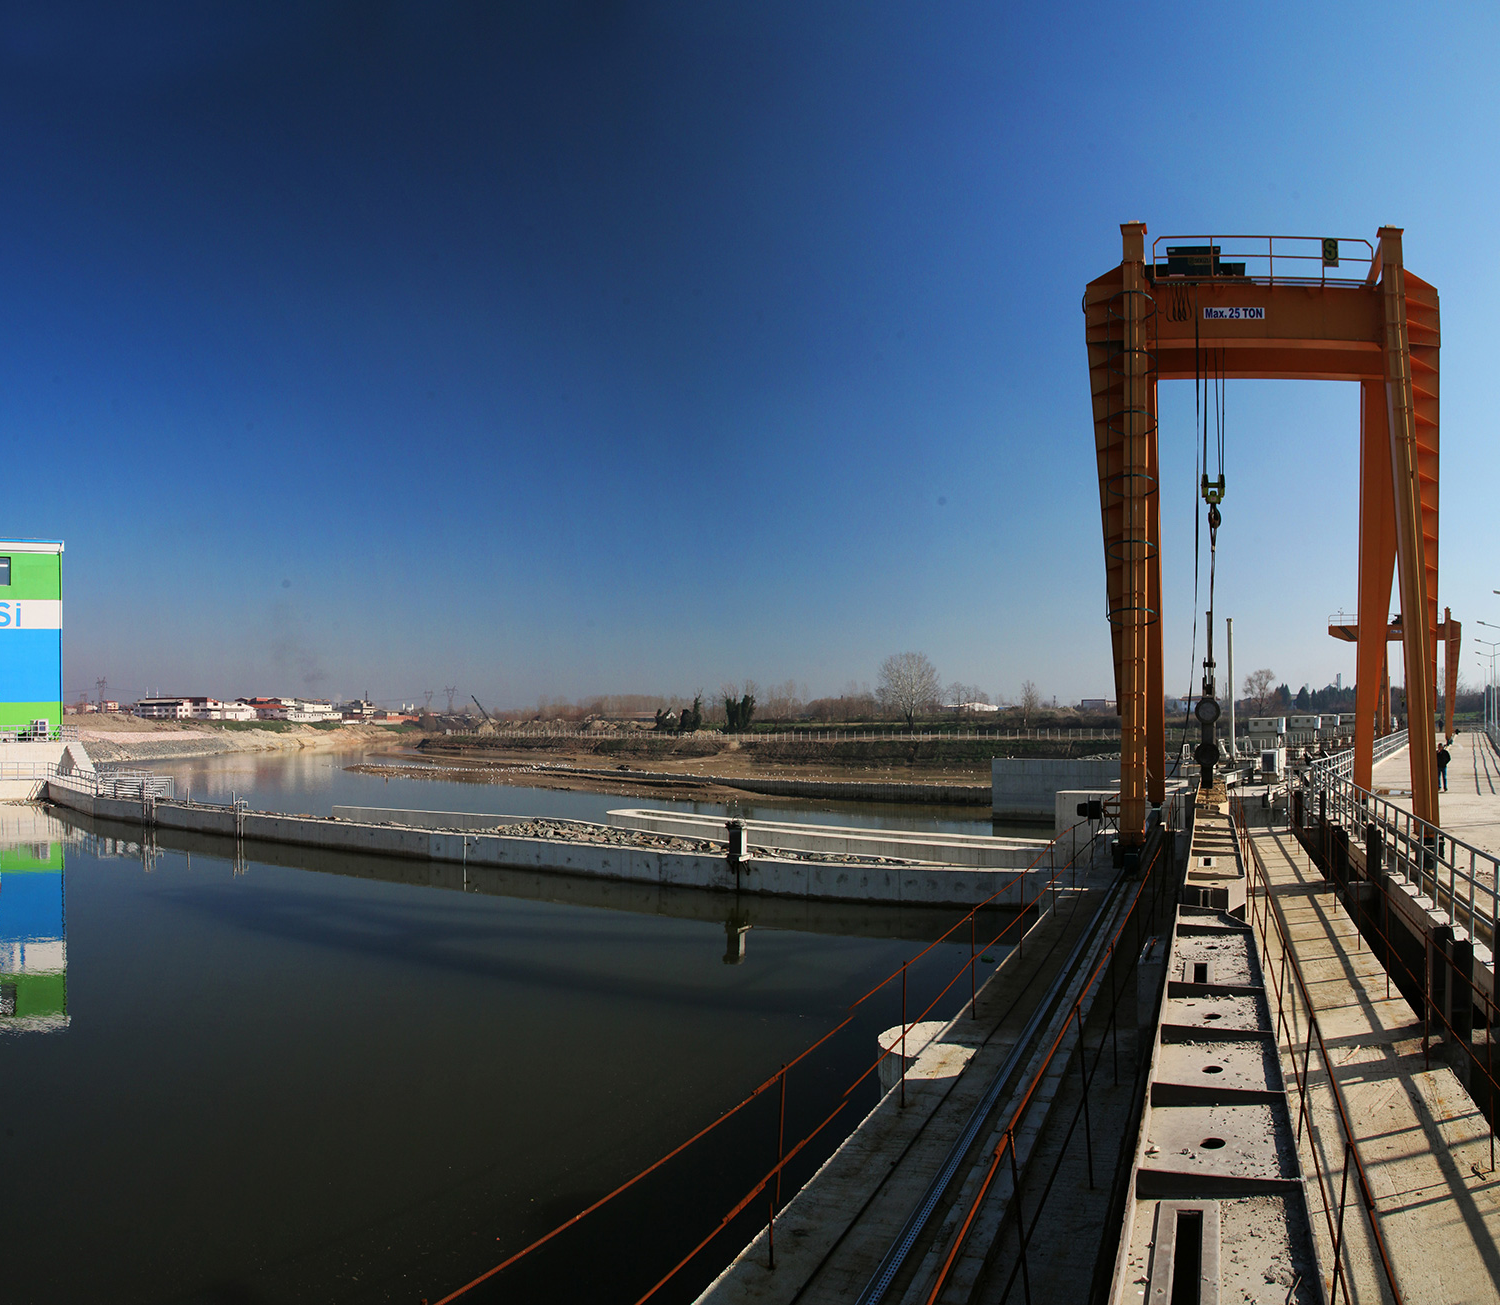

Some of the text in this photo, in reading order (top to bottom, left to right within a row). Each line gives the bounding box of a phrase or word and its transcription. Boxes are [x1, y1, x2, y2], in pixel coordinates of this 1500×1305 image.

[1205, 308, 1263, 319] Max. 25 TON
